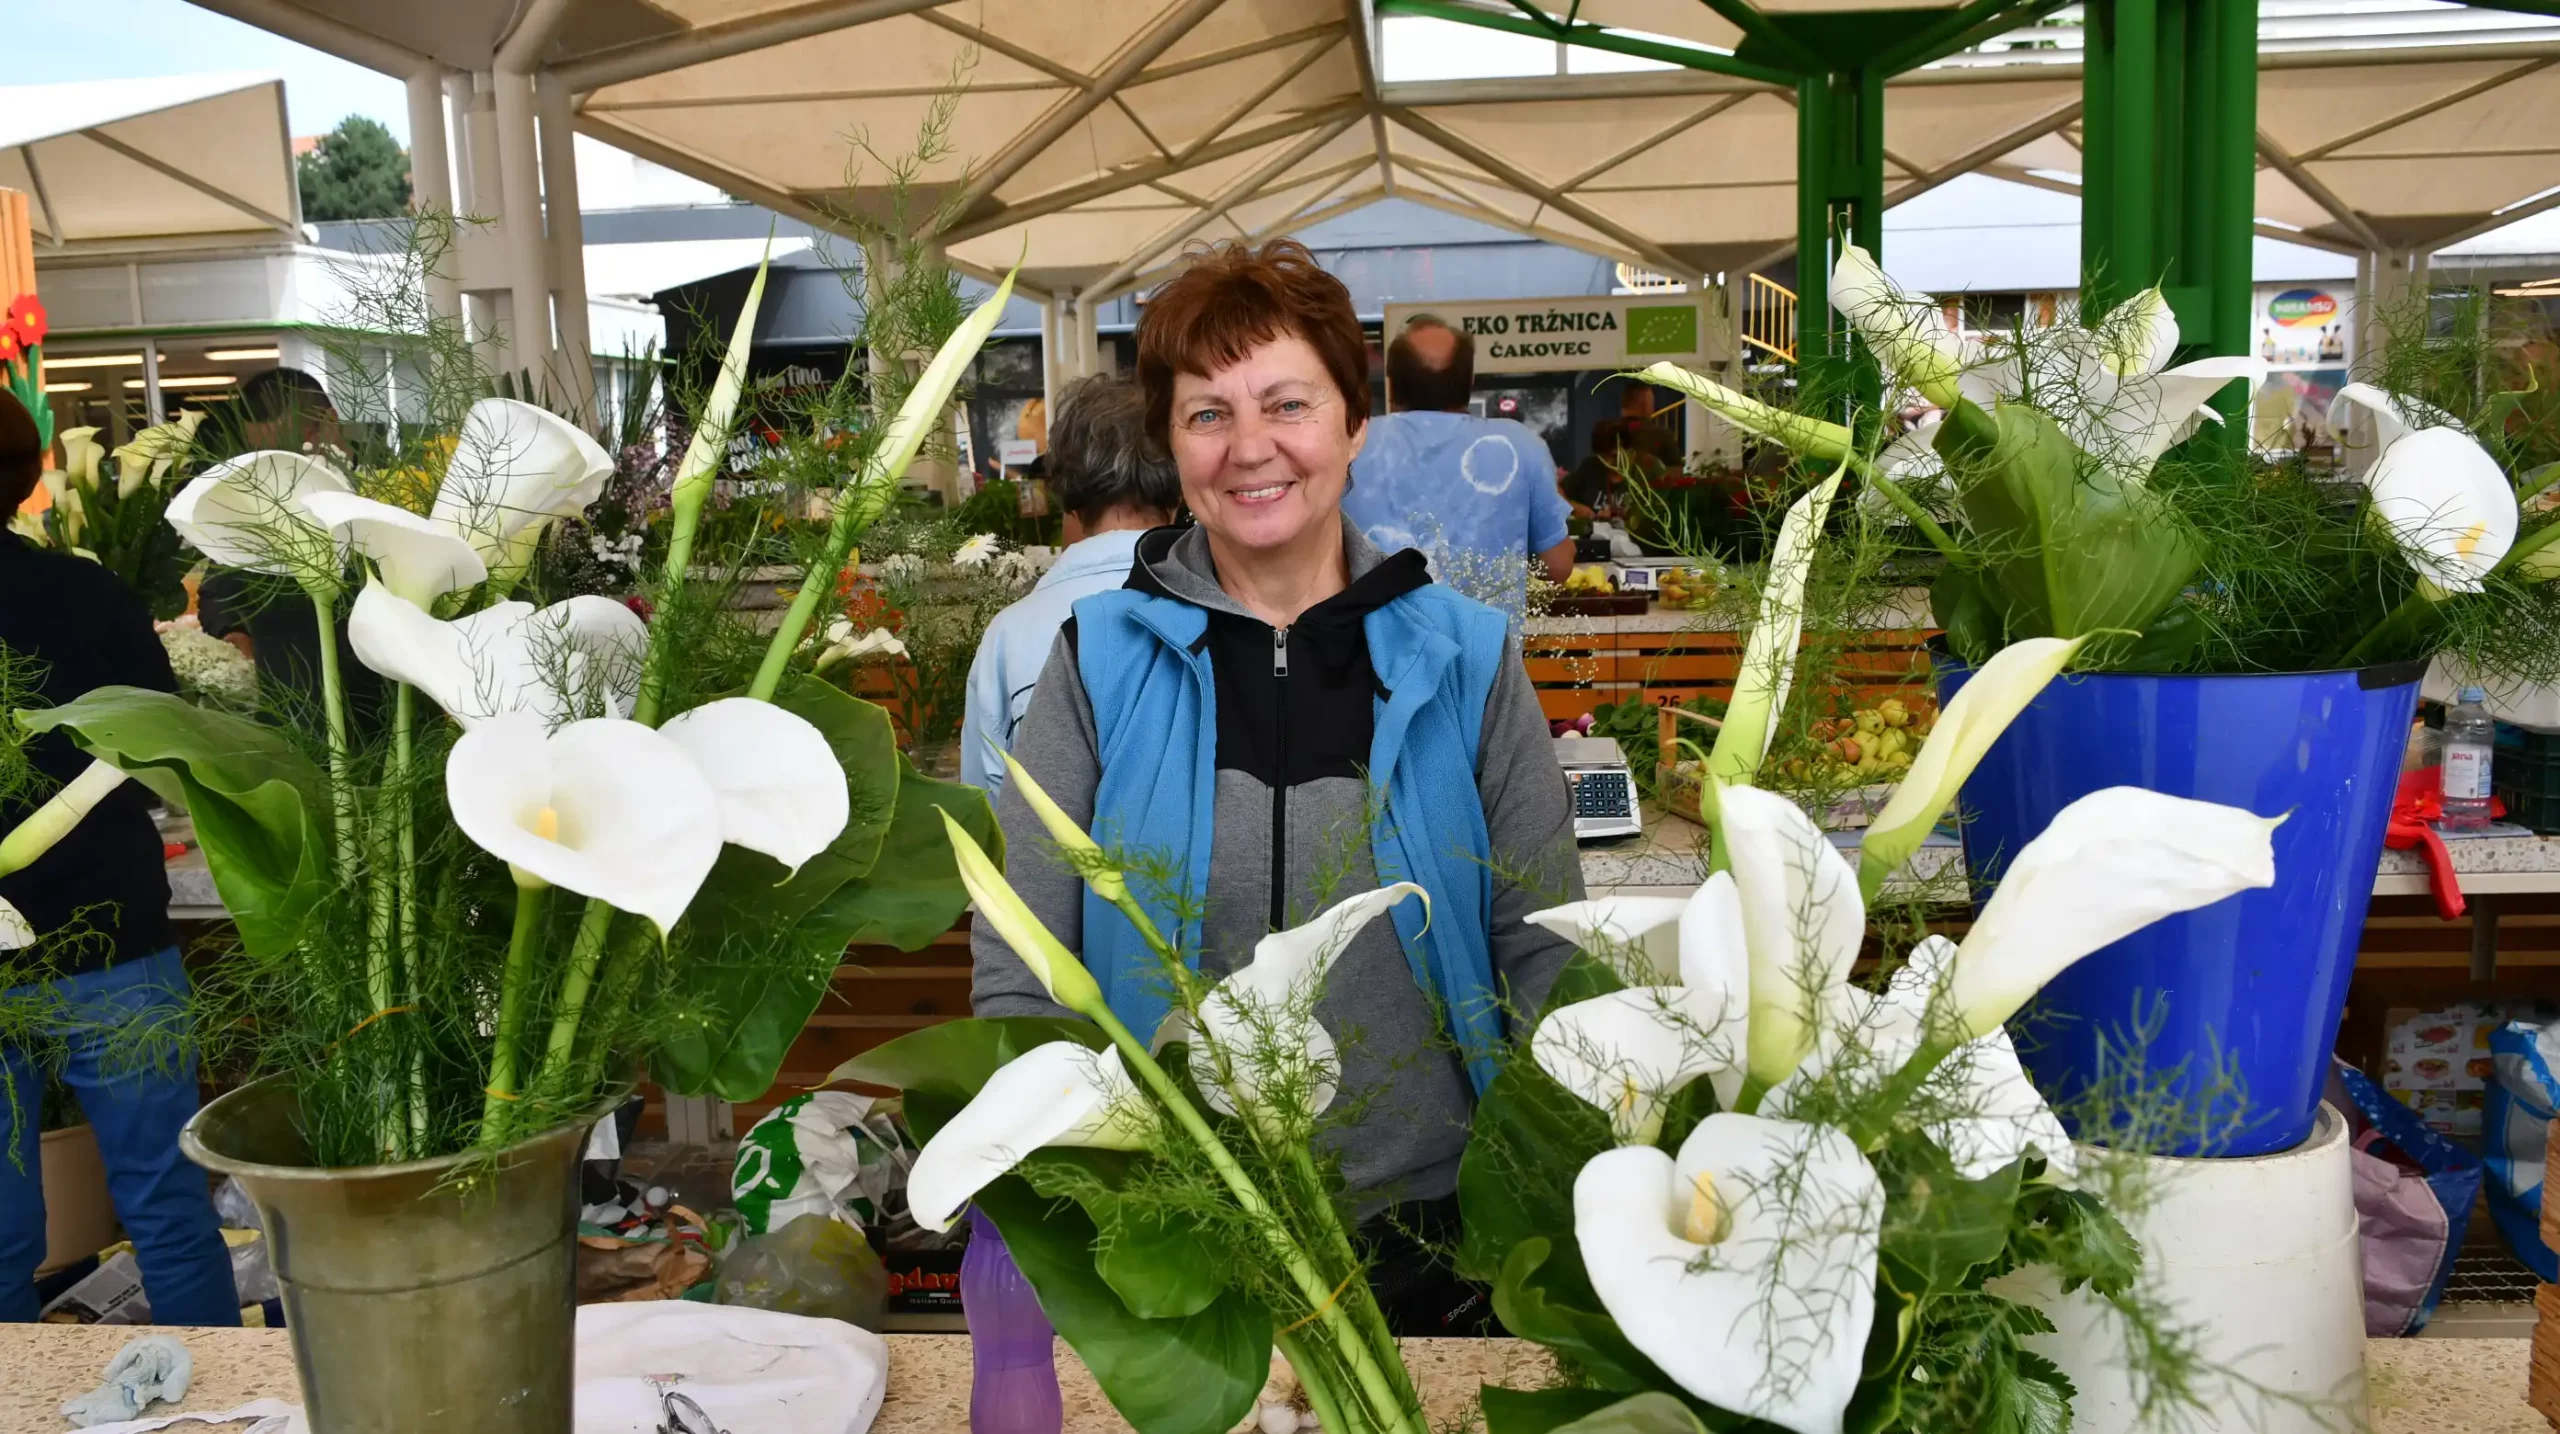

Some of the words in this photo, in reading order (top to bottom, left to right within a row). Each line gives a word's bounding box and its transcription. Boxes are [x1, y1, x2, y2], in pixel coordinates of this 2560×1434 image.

[1462, 314, 1509, 335] EKO
[1515, 308, 1618, 334] TRŽNICA
[1489, 341, 1592, 358] ČAKOVEC
[1447, 1295, 1477, 1322] SPORT
